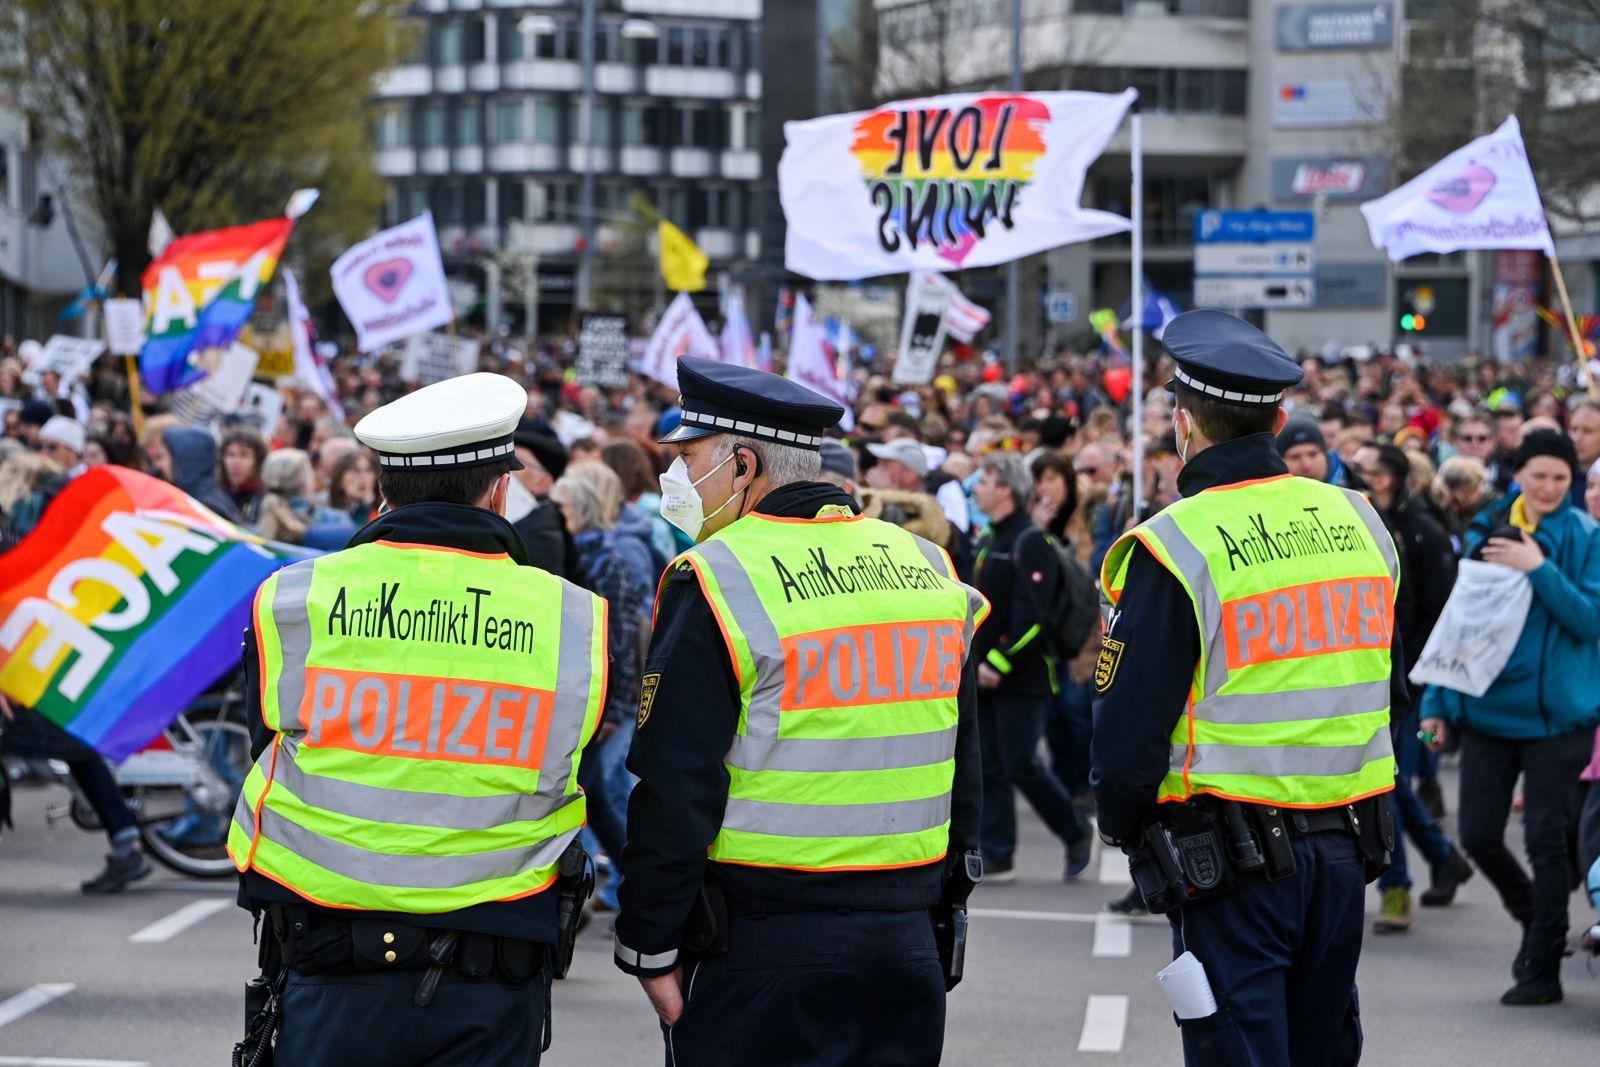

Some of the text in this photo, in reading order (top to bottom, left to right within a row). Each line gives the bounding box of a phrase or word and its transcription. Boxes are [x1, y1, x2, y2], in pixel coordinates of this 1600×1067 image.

[771, 543, 944, 603] AntiKonfliktTeam
[1216, 507, 1366, 571] AntiKonfliktTeam
[328, 582, 535, 655] AntiKonfliktTeam
[1236, 580, 1389, 662] POLIZEI
[795, 625, 963, 706] POLIZE
[309, 673, 540, 762] POLIZEI
